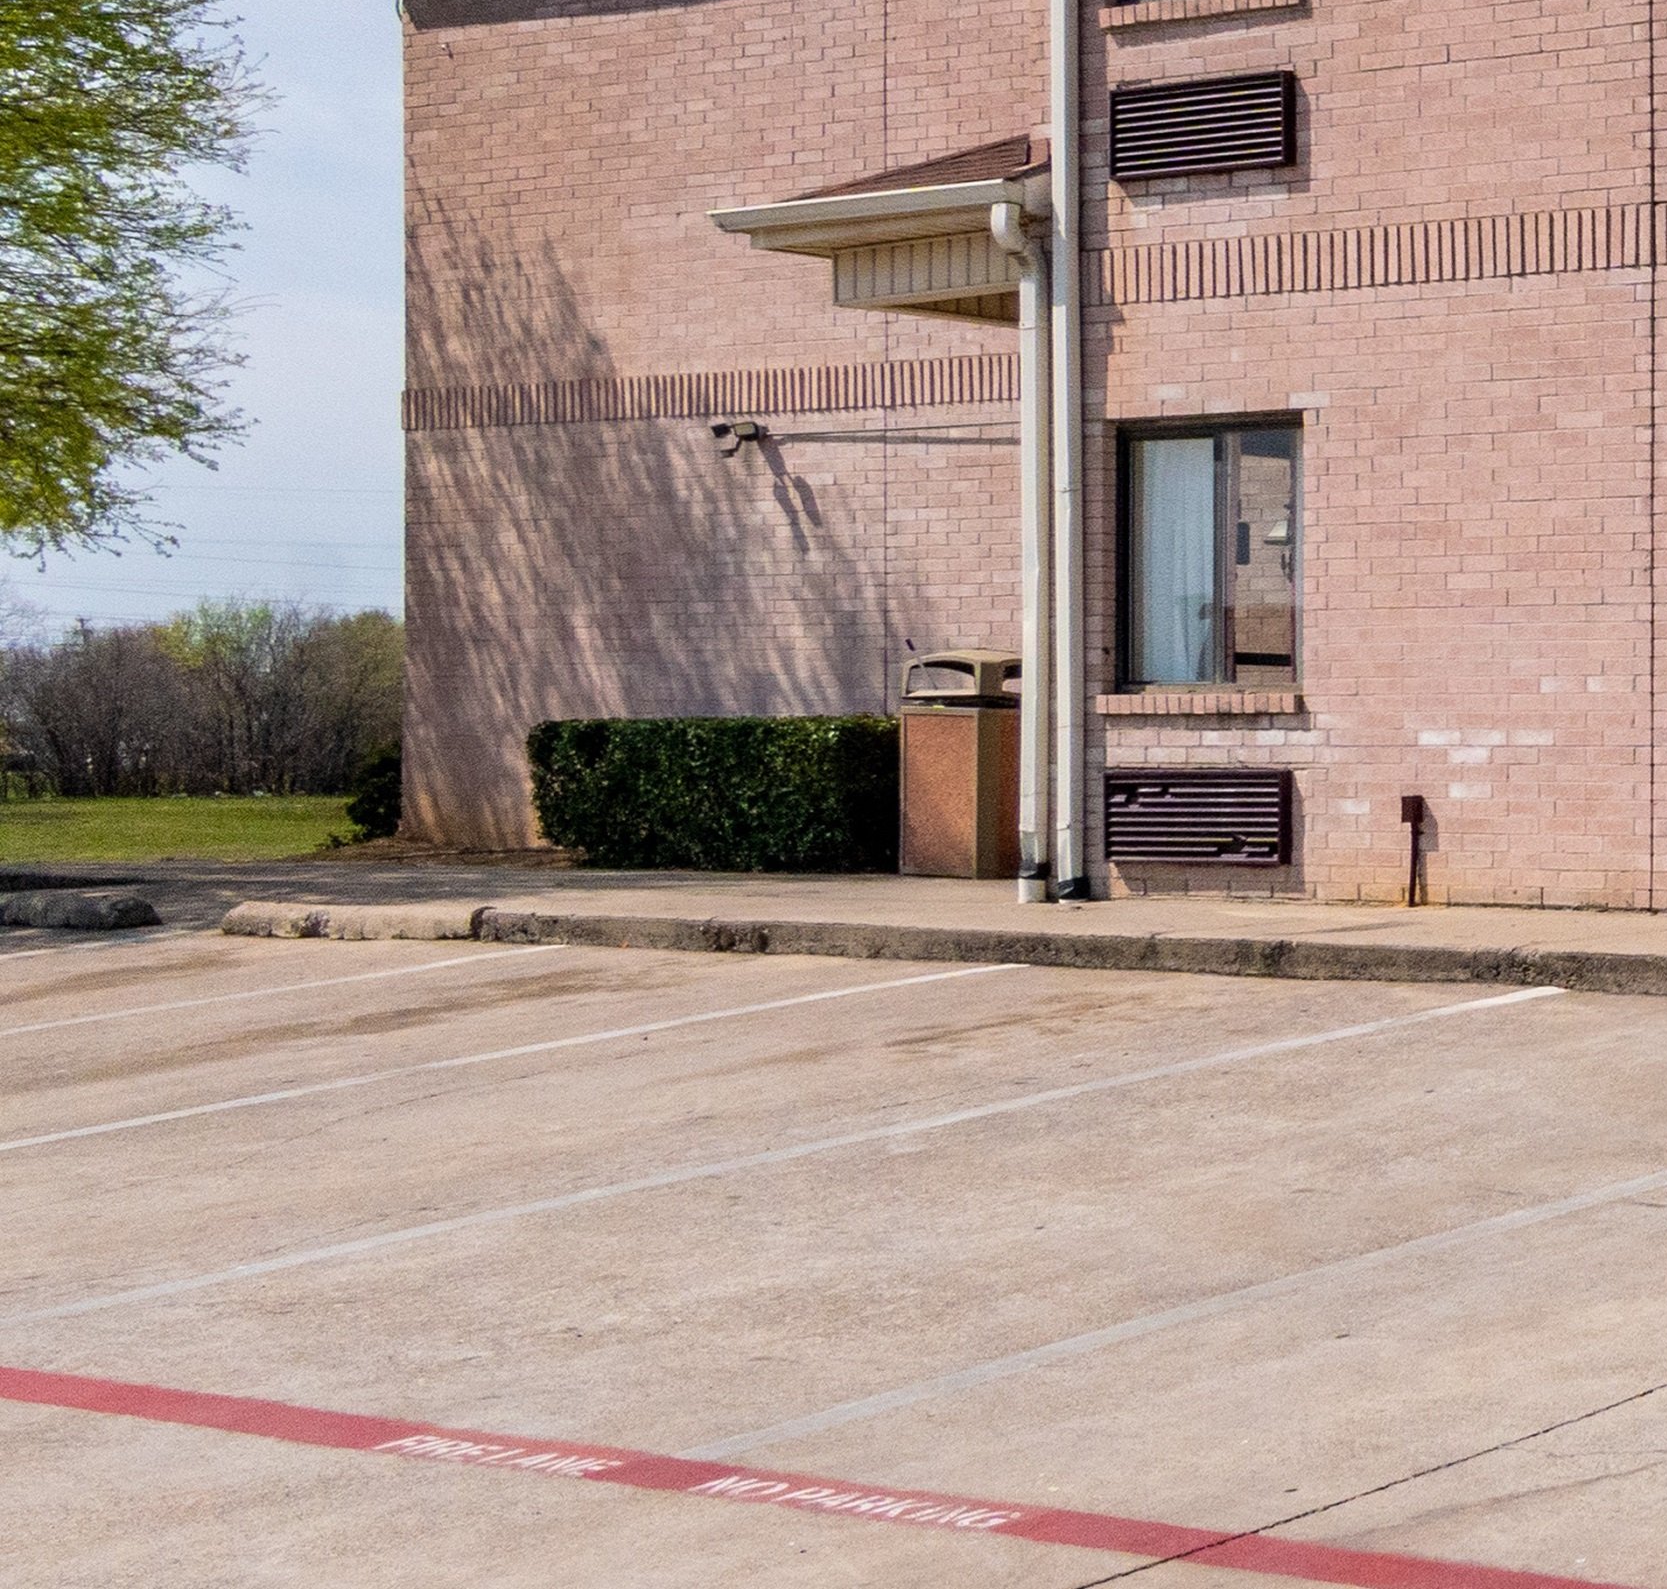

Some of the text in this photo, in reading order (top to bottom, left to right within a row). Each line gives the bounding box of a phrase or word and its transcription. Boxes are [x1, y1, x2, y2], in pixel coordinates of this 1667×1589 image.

[373, 1435, 621, 1476] FIRE LANE
[688, 1476, 1021, 1528] NO PARKING
